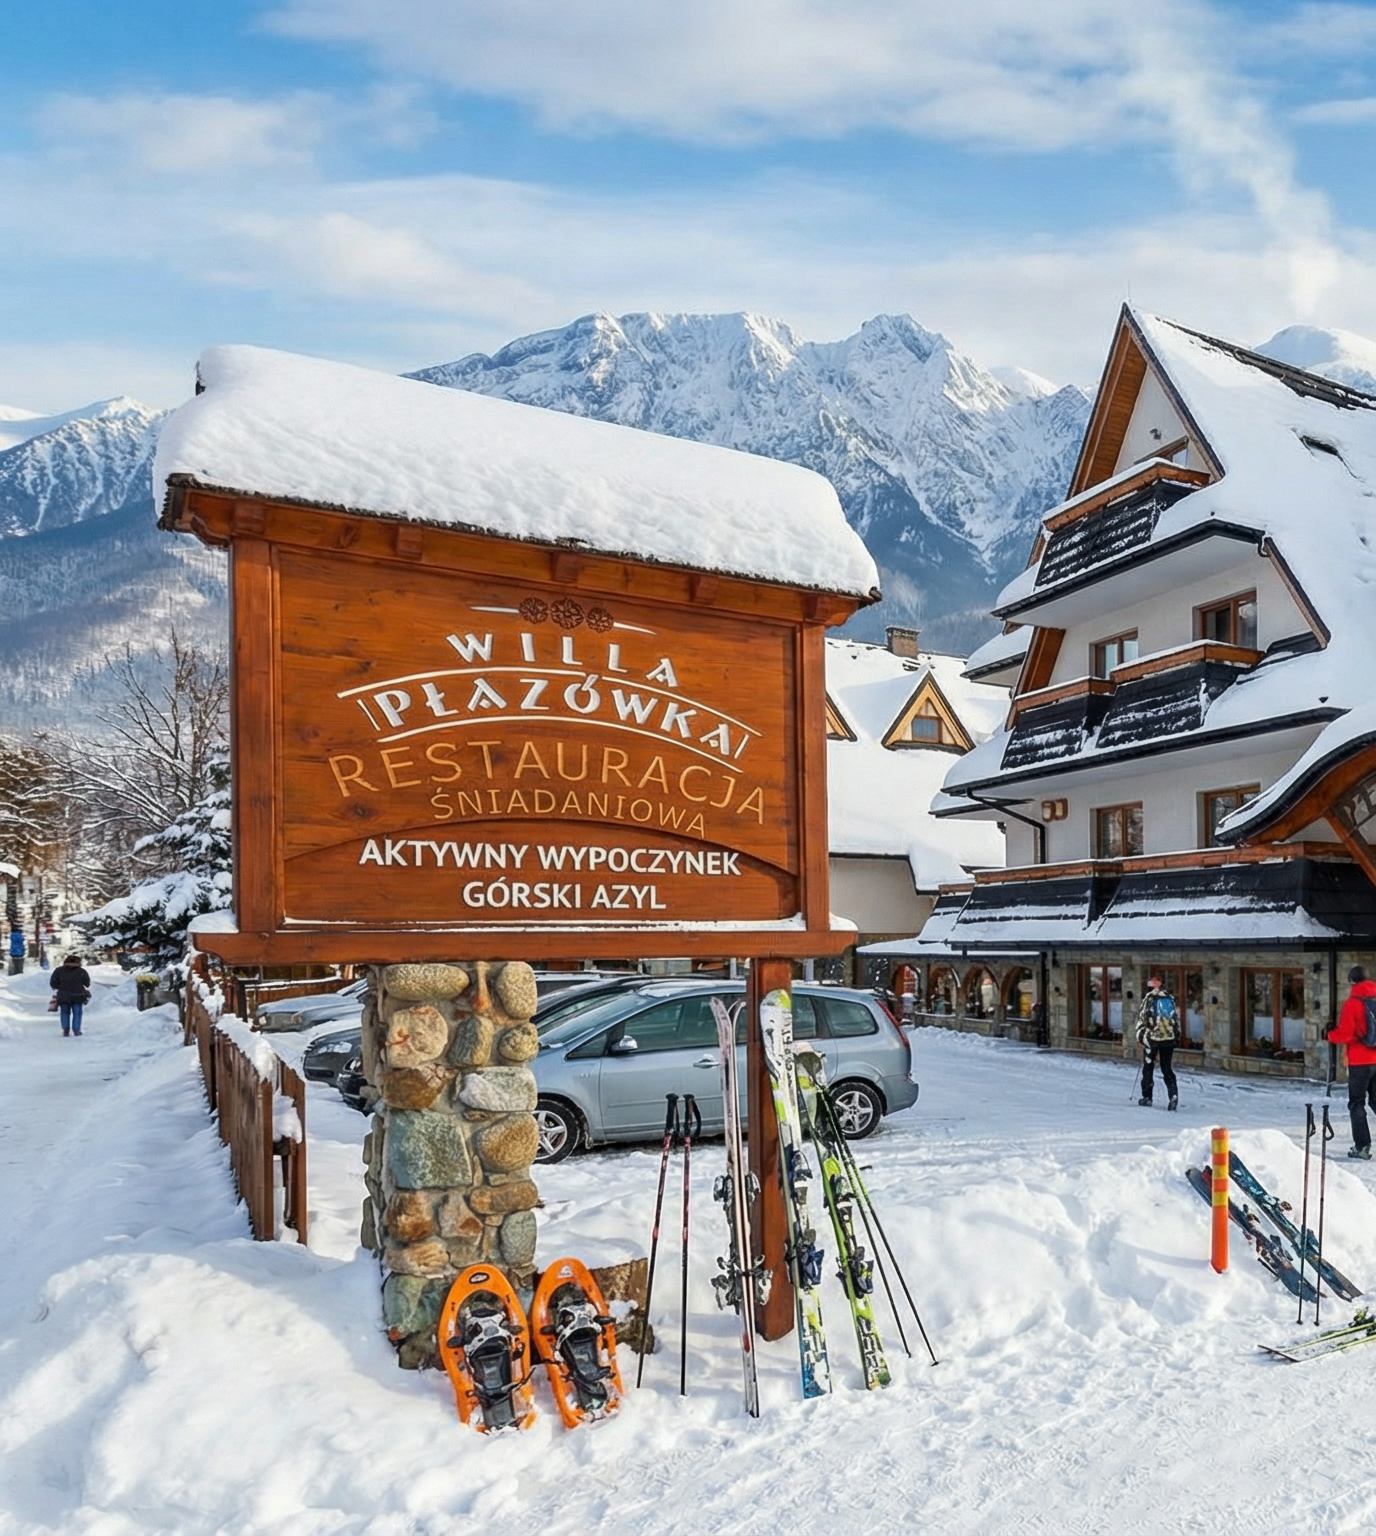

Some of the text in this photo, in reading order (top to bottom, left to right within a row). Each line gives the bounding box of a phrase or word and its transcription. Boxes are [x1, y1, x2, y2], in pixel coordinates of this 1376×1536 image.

[446, 632, 680, 688] WILLA
[373, 673, 732, 756] PŁAZÓWKA
[328, 740, 766, 825] RESTAURACJA
[430, 786, 708, 838] ŚNIADANIOWA
[358, 838, 742, 876] AKTYWNY WYPOCZYNEK
[462, 877, 667, 910] GÓRSKI AZYL
